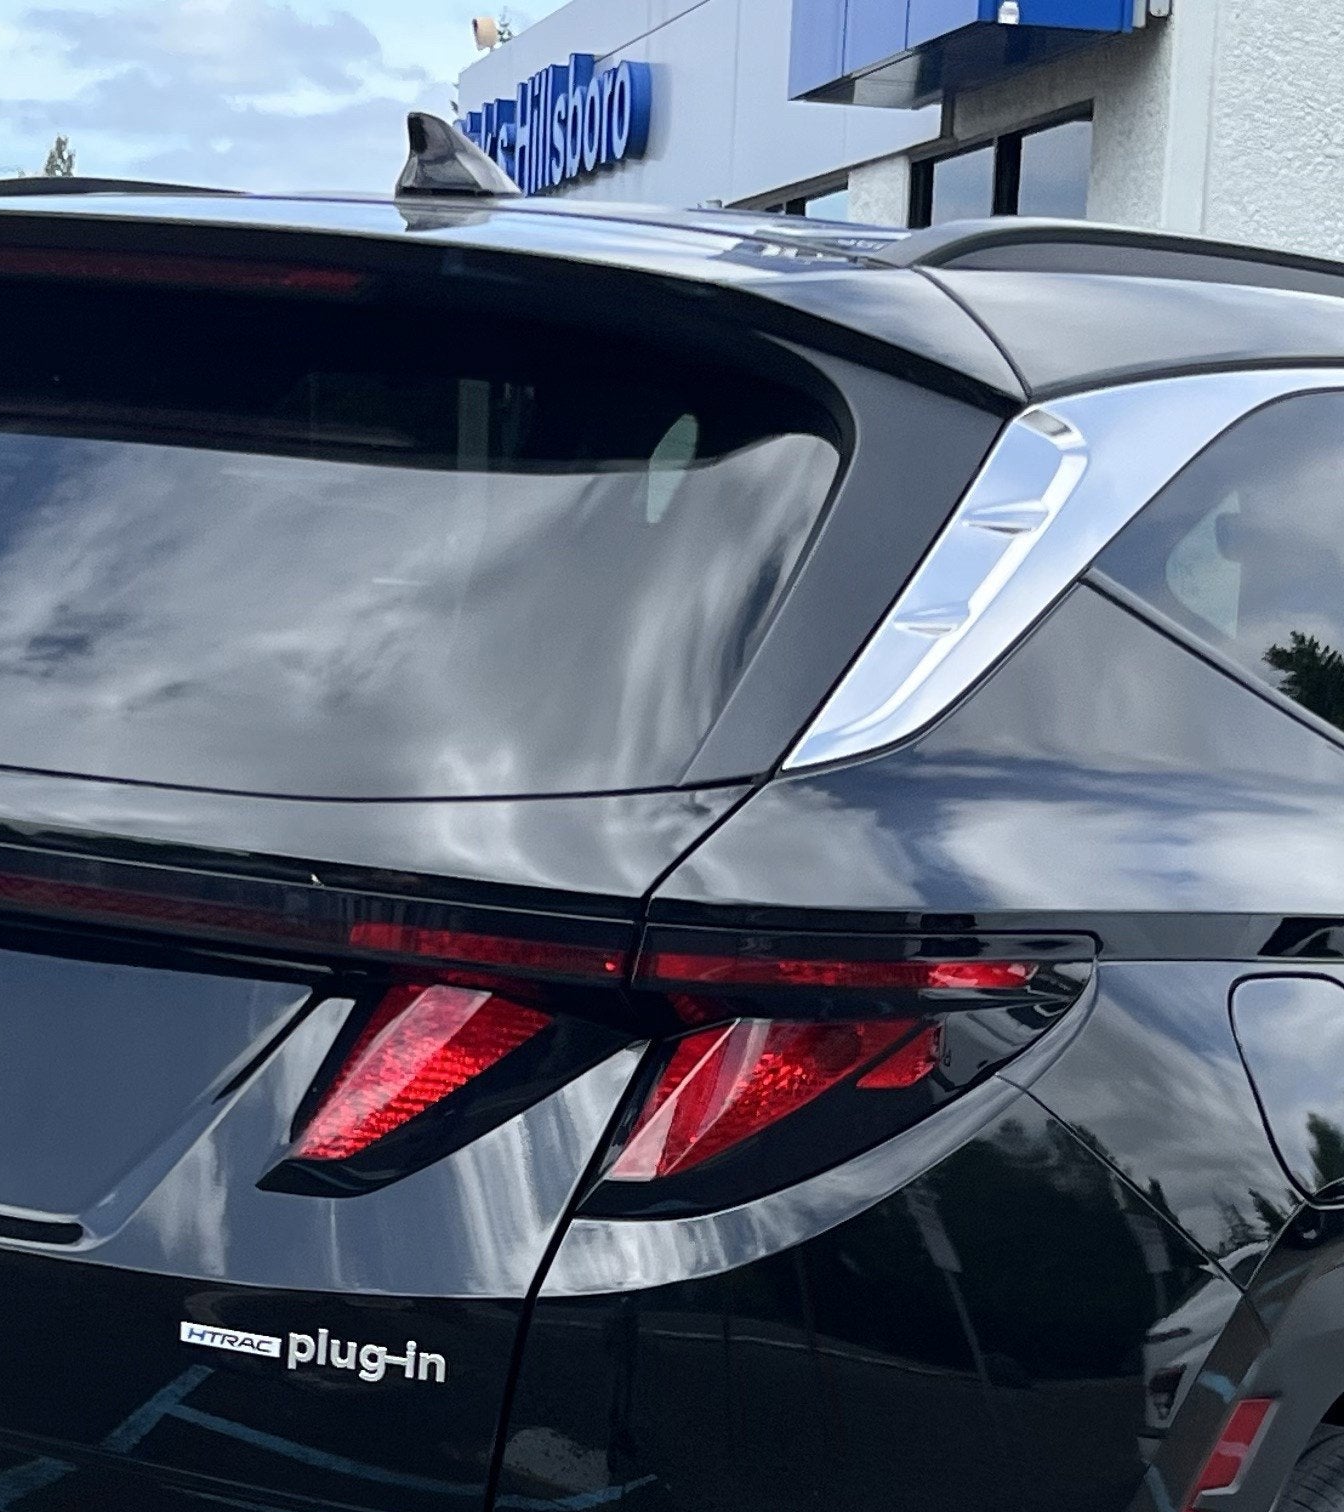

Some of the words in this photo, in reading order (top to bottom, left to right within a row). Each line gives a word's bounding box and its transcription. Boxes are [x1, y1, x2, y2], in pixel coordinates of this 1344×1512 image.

[514, 53, 634, 196] Hillsboro
[187, 1327, 274, 1353] HTRAC
[287, 1328, 447, 1383] plug-in
